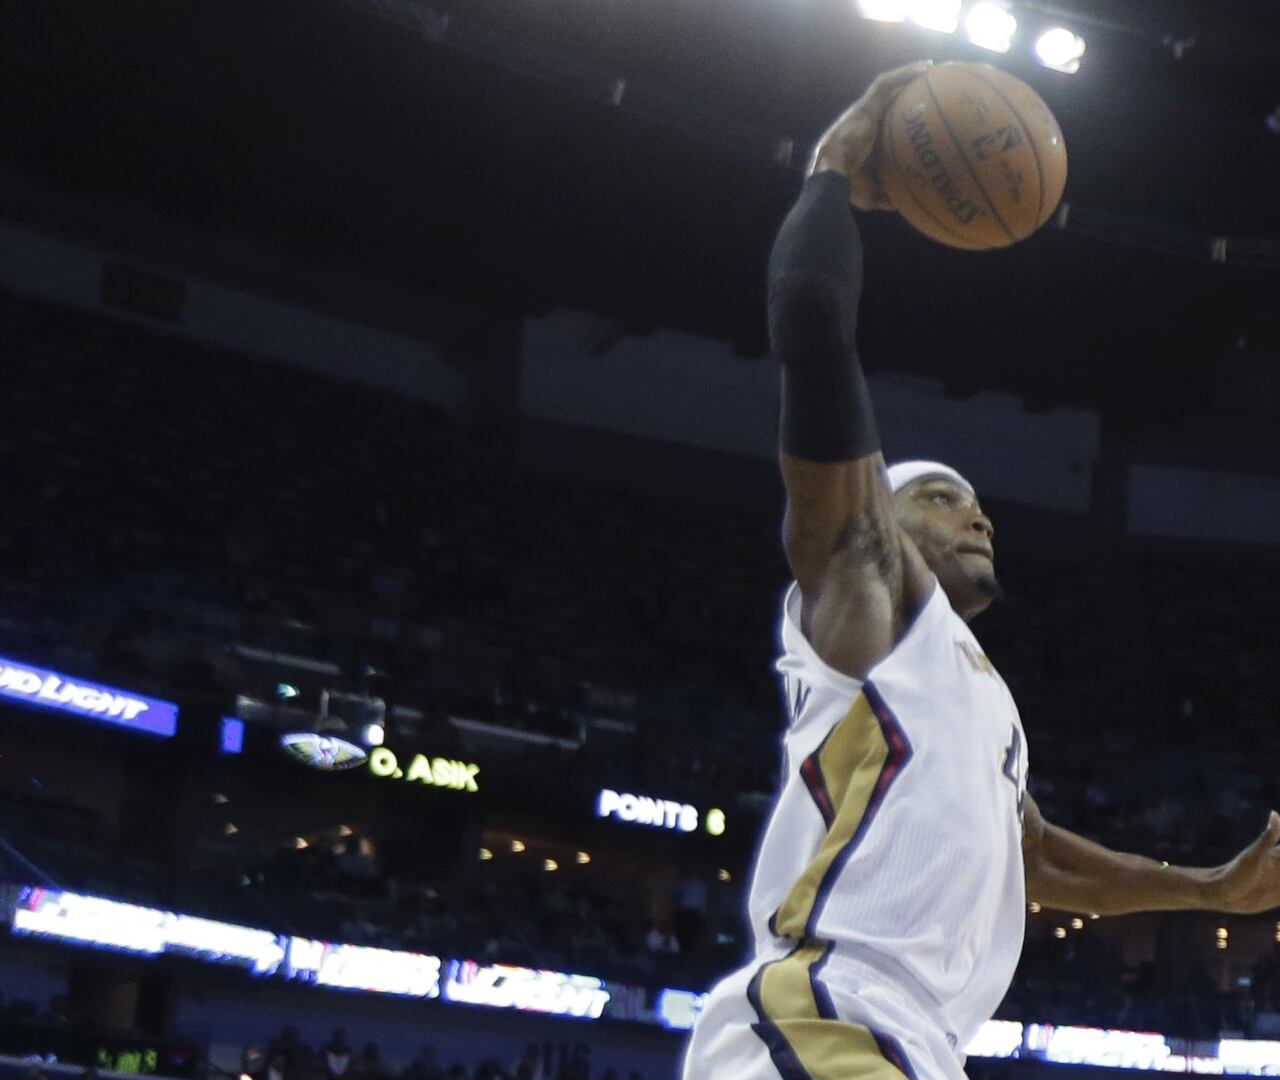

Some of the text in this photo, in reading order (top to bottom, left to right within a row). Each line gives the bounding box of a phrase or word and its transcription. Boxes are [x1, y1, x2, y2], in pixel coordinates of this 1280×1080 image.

[39, 675, 149, 720] LIGHT
[369, 747, 481, 793] O. ASIK
[599, 788, 699, 832] POINTS
